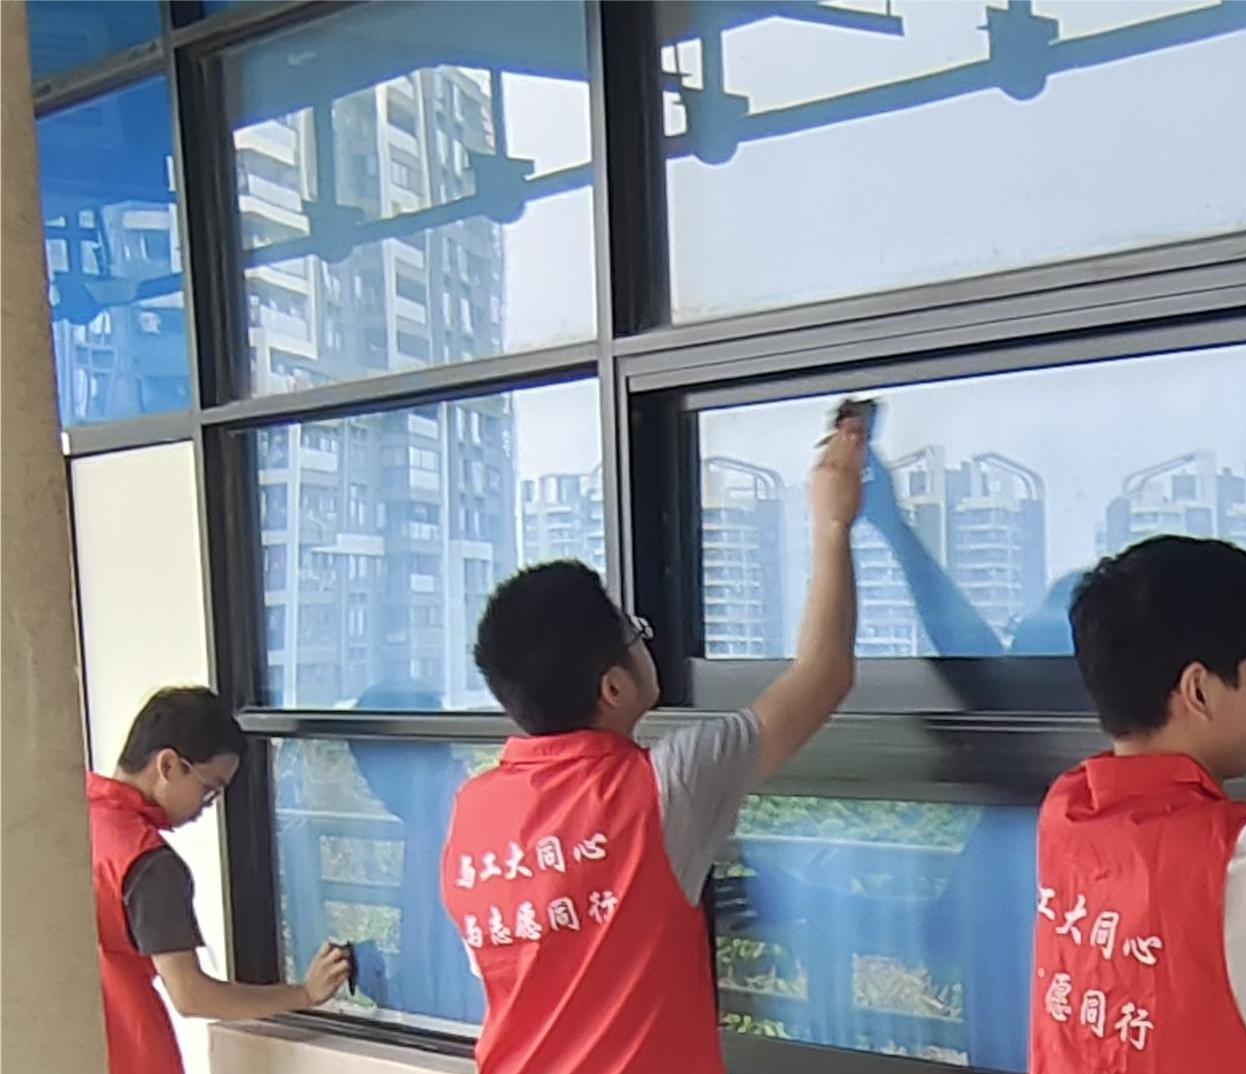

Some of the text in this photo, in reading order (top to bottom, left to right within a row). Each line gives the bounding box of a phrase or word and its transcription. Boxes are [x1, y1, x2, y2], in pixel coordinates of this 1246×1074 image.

[456, 833, 608, 889] 与工大同心
[464, 890, 618, 949] 与志愿同行
[1037, 968, 1154, 1050] 愿同行
